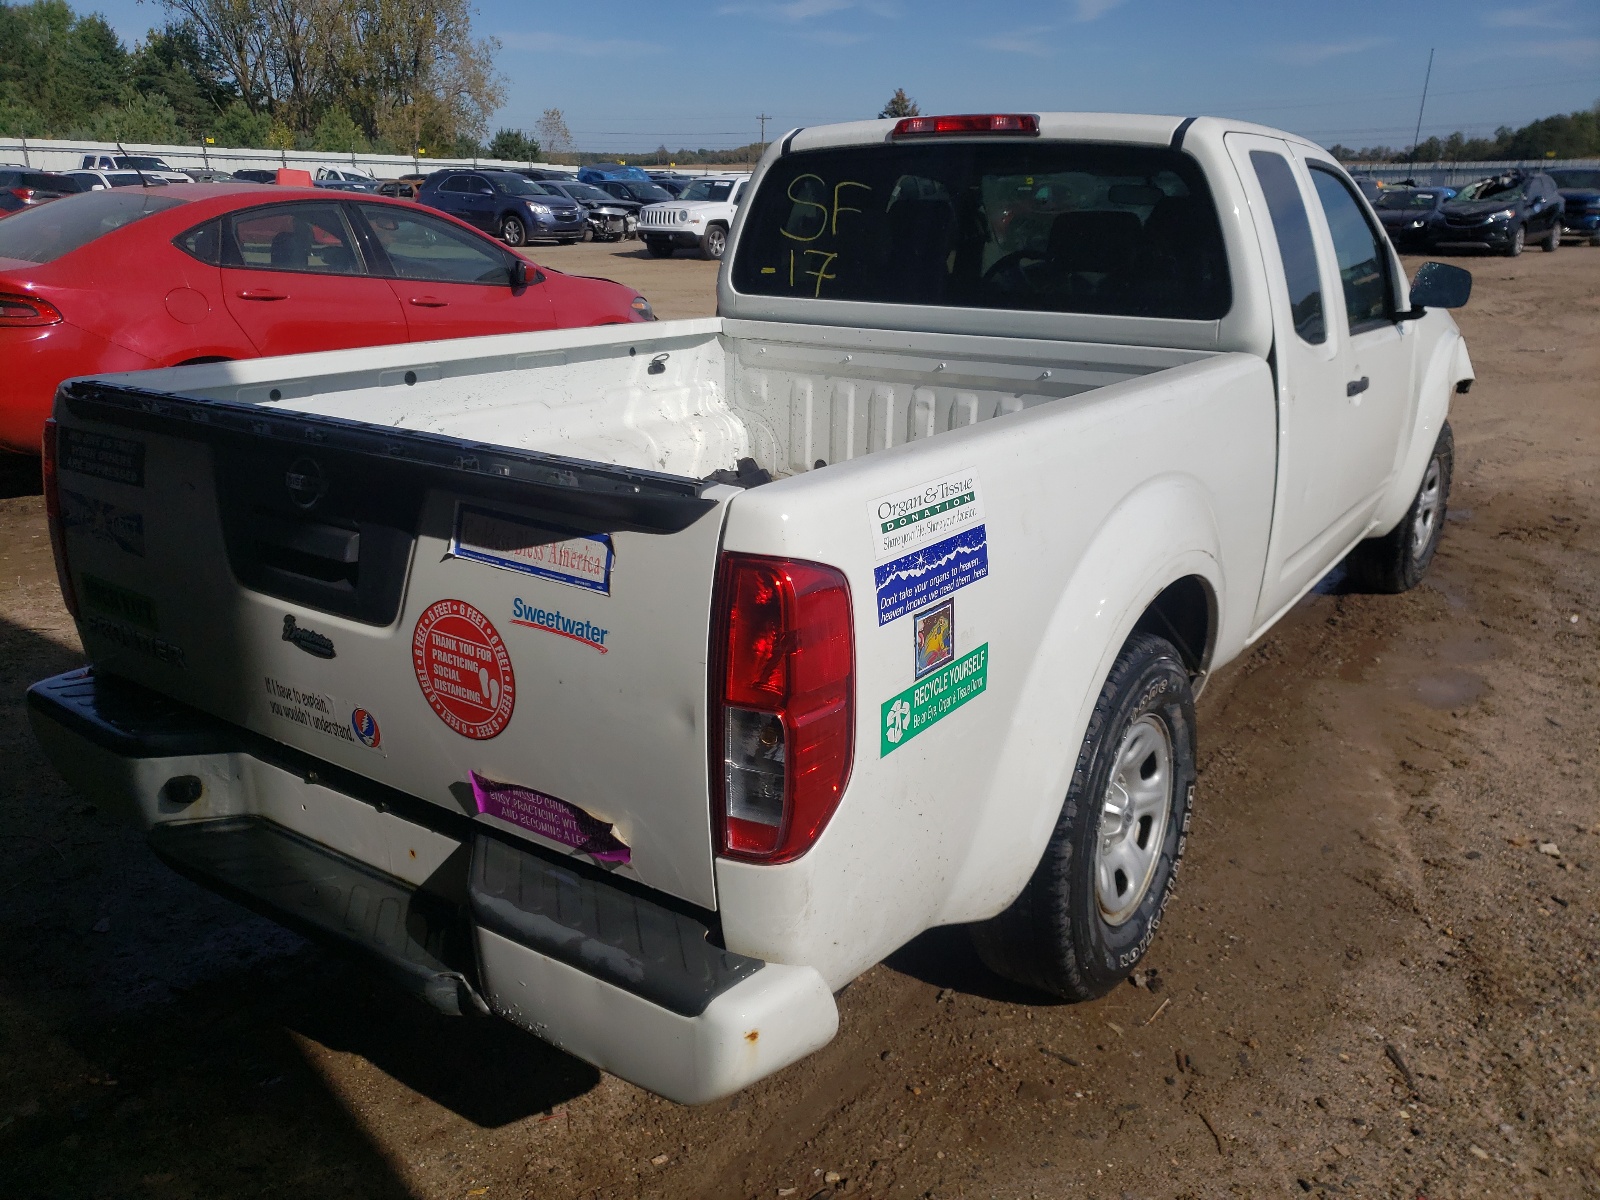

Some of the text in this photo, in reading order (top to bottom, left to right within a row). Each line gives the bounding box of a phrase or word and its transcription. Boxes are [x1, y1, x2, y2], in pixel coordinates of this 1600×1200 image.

[779, 172, 873, 241] SF
[878, 478, 973, 519] Organ & Tissue
[886, 494, 971, 531] DONATION
[884, 534, 901, 551] Share
[926, 519, 940, 534] Share
[548, 542, 601, 575] America
[880, 593, 897, 610] Don't
[899, 586, 912, 602] take
[914, 581, 928, 598] your
[930, 572, 950, 590] organs
[951, 568, 958, 579] to
[880, 564, 988, 623] heaven knows we need them here!
[428, 602, 452, 622] 6 FEET
[460, 604, 488, 629] 6 FEET
[513, 597, 609, 645] Sweetwater
[415, 624, 428, 656] 6 FEET
[432, 634, 492, 662] THANK YOU FOR
[491, 636, 511, 672] 6 FEET
[432, 649, 479, 674] PRACTICING
[434, 664, 461, 682] SOCIAL
[265, 677, 272, 694] If
[276, 681, 292, 702] have
[293, 688, 301, 704] to
[418, 668, 433, 694] FEET
[434, 678, 483, 704] DISTANCING.
[914, 651, 984, 708] RECYCLE YOURSELF
[500, 684, 512, 719] 6 FEET
[913, 714, 921, 729] Be
[938, 698, 952, 713] Organ
[957, 686, 970, 701] Tissue
[270, 701, 355, 742] you wouldn't understand.
[440, 710, 468, 734] 6 FEET
[476, 720, 500, 737] 6 FEET
[490, 791, 510, 806] BUSY
[512, 798, 560, 825] PRACTICING
[513, 789, 543, 805] MISSED
[501, 807, 518, 820] AND
[520, 813, 562, 839] BECOMING
[564, 830, 570, 841] A
